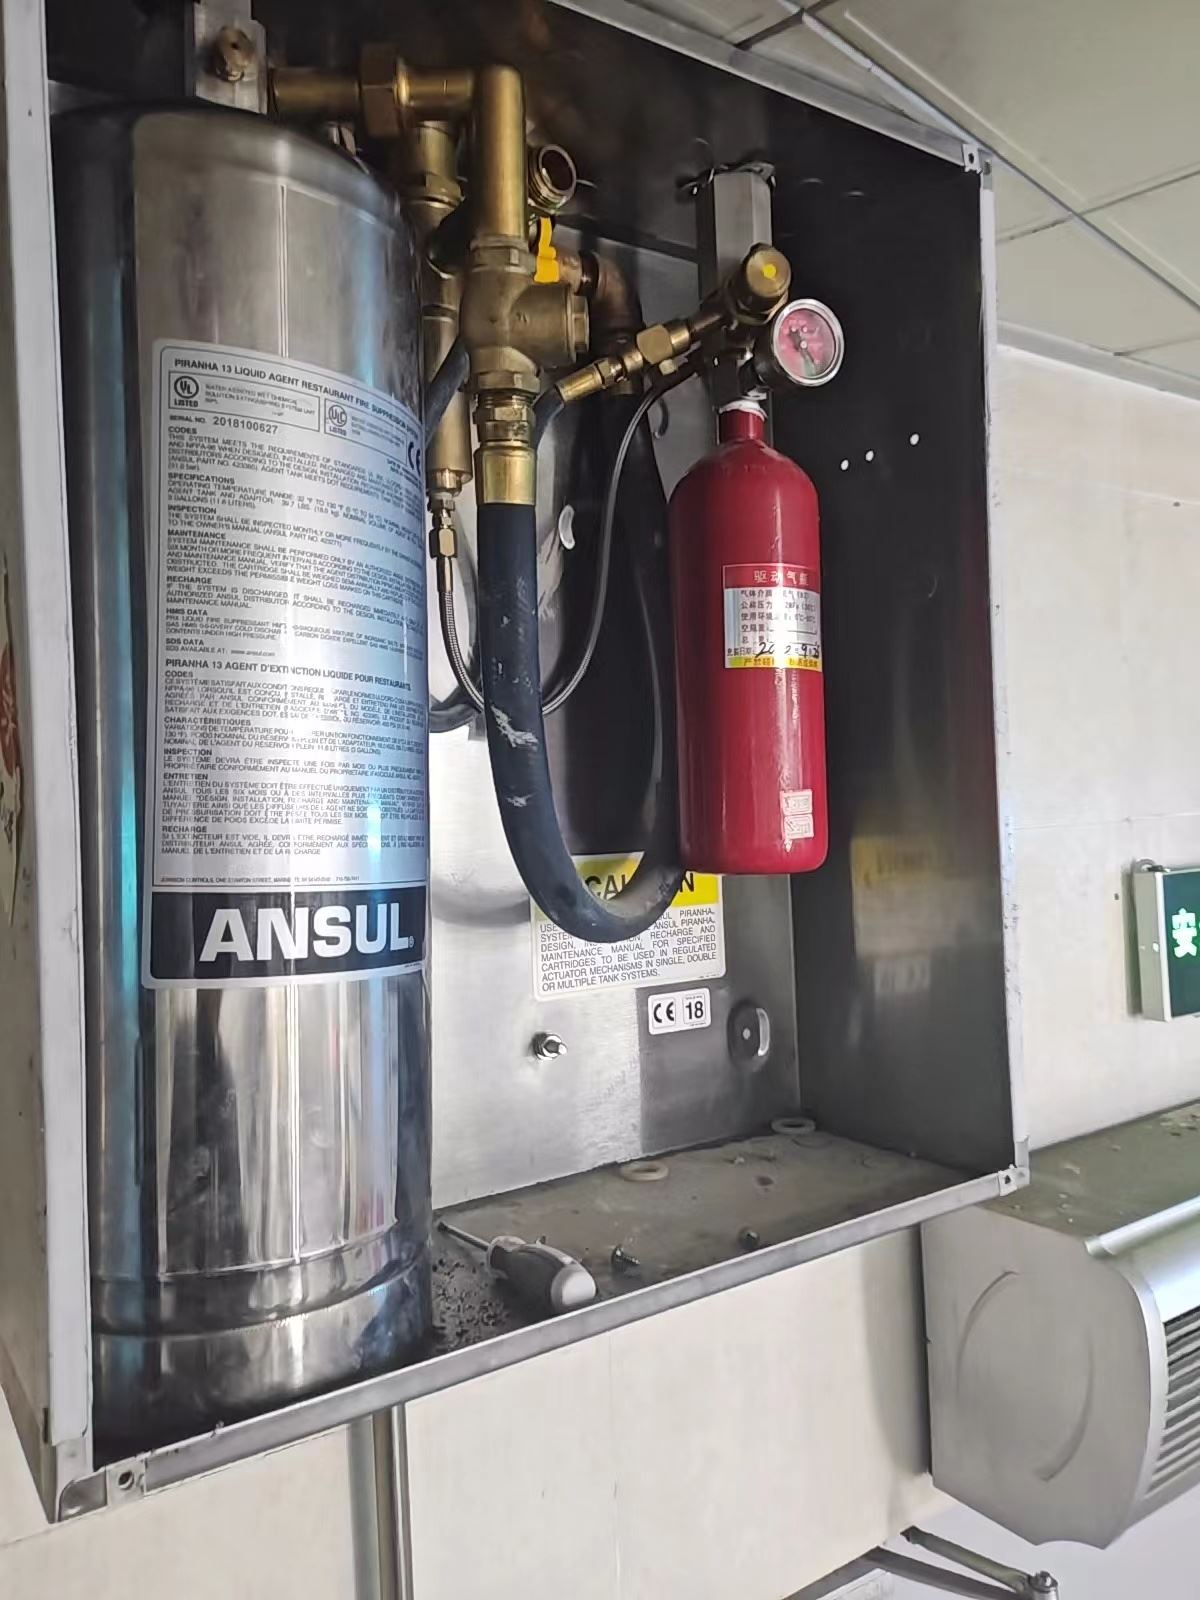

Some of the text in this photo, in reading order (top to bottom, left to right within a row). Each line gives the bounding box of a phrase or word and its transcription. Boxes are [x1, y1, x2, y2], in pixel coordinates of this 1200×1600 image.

[175, 359, 218, 371] PIRANHA
[222, 364, 231, 373] 13
[235, 366, 265, 379] LIQUID
[269, 371, 299, 386] AGENT
[302, 380, 354, 402] RESTAURANT
[174, 399, 198, 407] LISTED
[214, 416, 277, 434] 2018100627
[189, 435, 218, 443] SYSTEM
[222, 438, 247, 447] MEETS
[251, 442, 263, 450] THE
[219, 446, 240, 454] WHEN
[261, 464, 284, 474] AGENT
[168, 473, 235, 484] SPECIFICATIONS
[168, 481, 266, 496] OPERATING TEMPERATURE
[168, 505, 216, 513] INSPECTION
[217, 515, 239, 523] SHALL
[253, 519, 290, 529] INSPECTED
[232, 523, 261, 533] MANUAL
[168, 530, 226, 539] MAINTENANCE
[200, 539, 251, 549] MAINTENANCE
[254, 543, 275, 552] SHALL
[184, 552, 236, 561] MAINTENANCE
[296, 561, 311, 570] THAT
[167, 576, 212, 584] RECHARGE
[197, 584, 226, 592] SYSTEM
[304, 594, 323, 603] SHALL
[166, 659, 209, 668] PIRANHA
[212, 661, 222, 669] 13
[225, 662, 258, 671] AGENT
[323, 669, 353, 680] LIQUIDE
[355, 673, 373, 682] POUR
[654, 919, 676, 929] ANSUL
[199, 902, 409, 962] ANSUL
[651, 927, 693, 939] RECHARGE
[701, 925, 715, 935] AND
[541, 947, 602, 961] MAINTENANCE
[611, 943, 643, 955] MANUAL
[653, 939, 669, 950] FOR
[677, 934, 716, 947] SPECIFIED
[542, 943, 716, 971] CARTRIDGES TO BE USED IN REGULATED
[542, 968, 587, 981] ACTUATOR
[590, 962, 642, 976] MECHANISMS
[646, 960, 653, 970] IN
[687, 952, 716, 964] DOUBLE
[542, 969, 660, 991] OR MULTIPLE TANK SYSTEMS.
[654, 1002, 674, 1023] CE
[686, 1001, 703, 1020] 18
